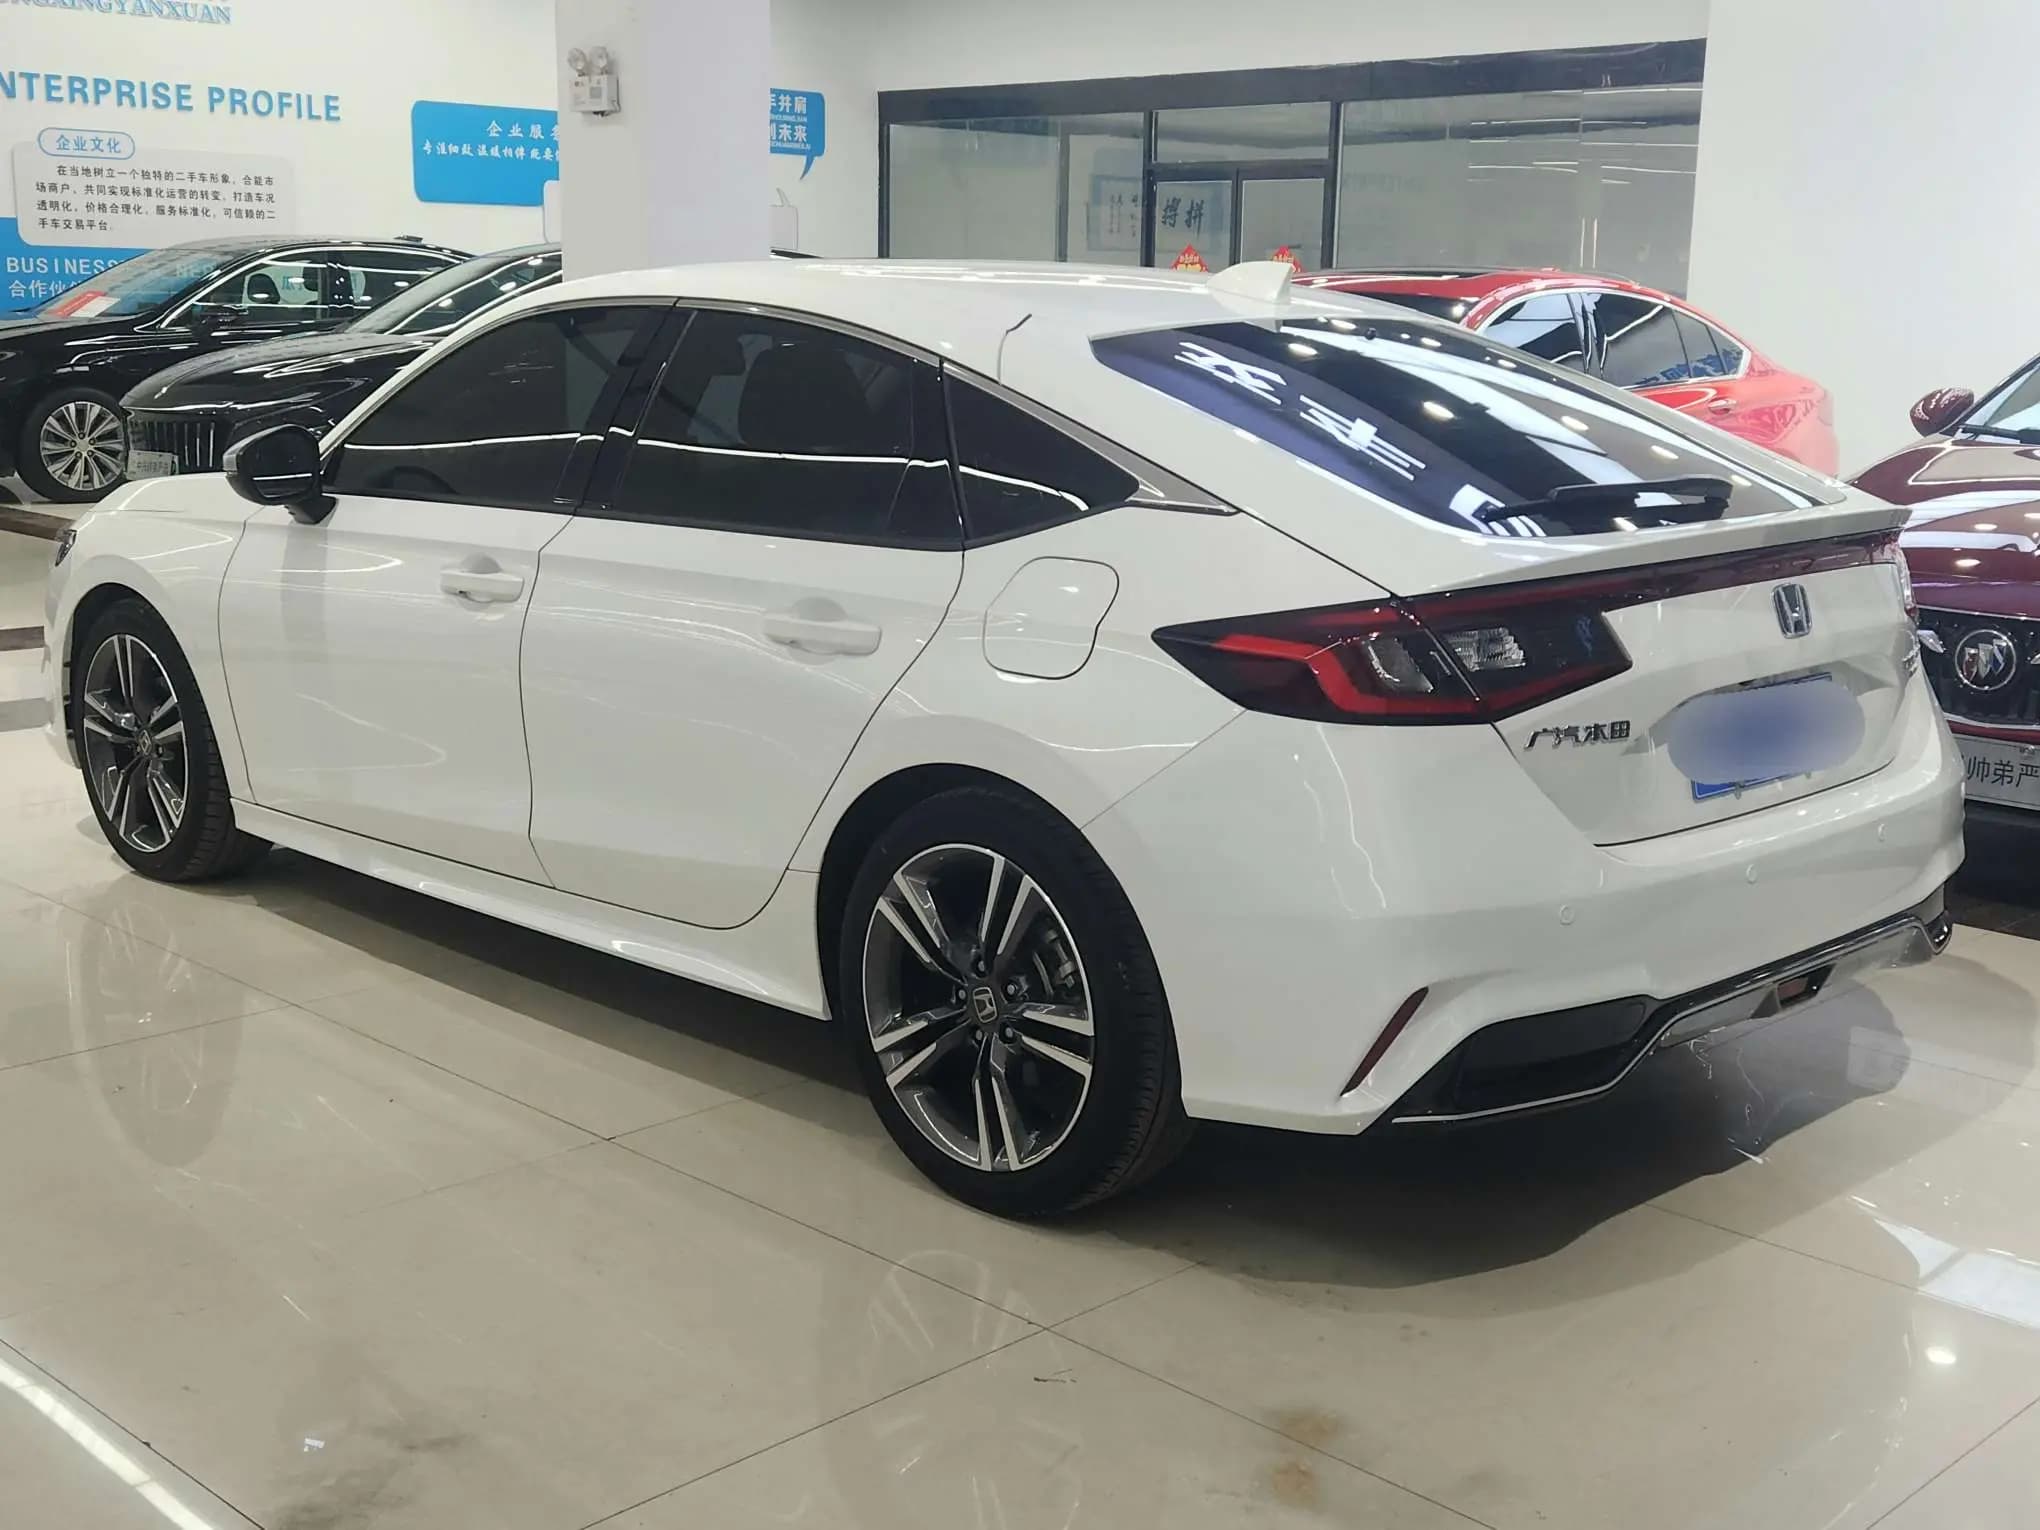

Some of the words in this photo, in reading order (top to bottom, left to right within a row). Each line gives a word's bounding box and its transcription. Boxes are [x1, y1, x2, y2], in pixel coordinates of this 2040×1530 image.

[0, 70, 194, 112] NTERPRISE
[208, 86, 341, 121] PROFILE
[56, 134, 121, 153] 企业文化
[9, 280, 80, 298] 合作伙
[1523, 720, 1631, 751] 广汽本田
